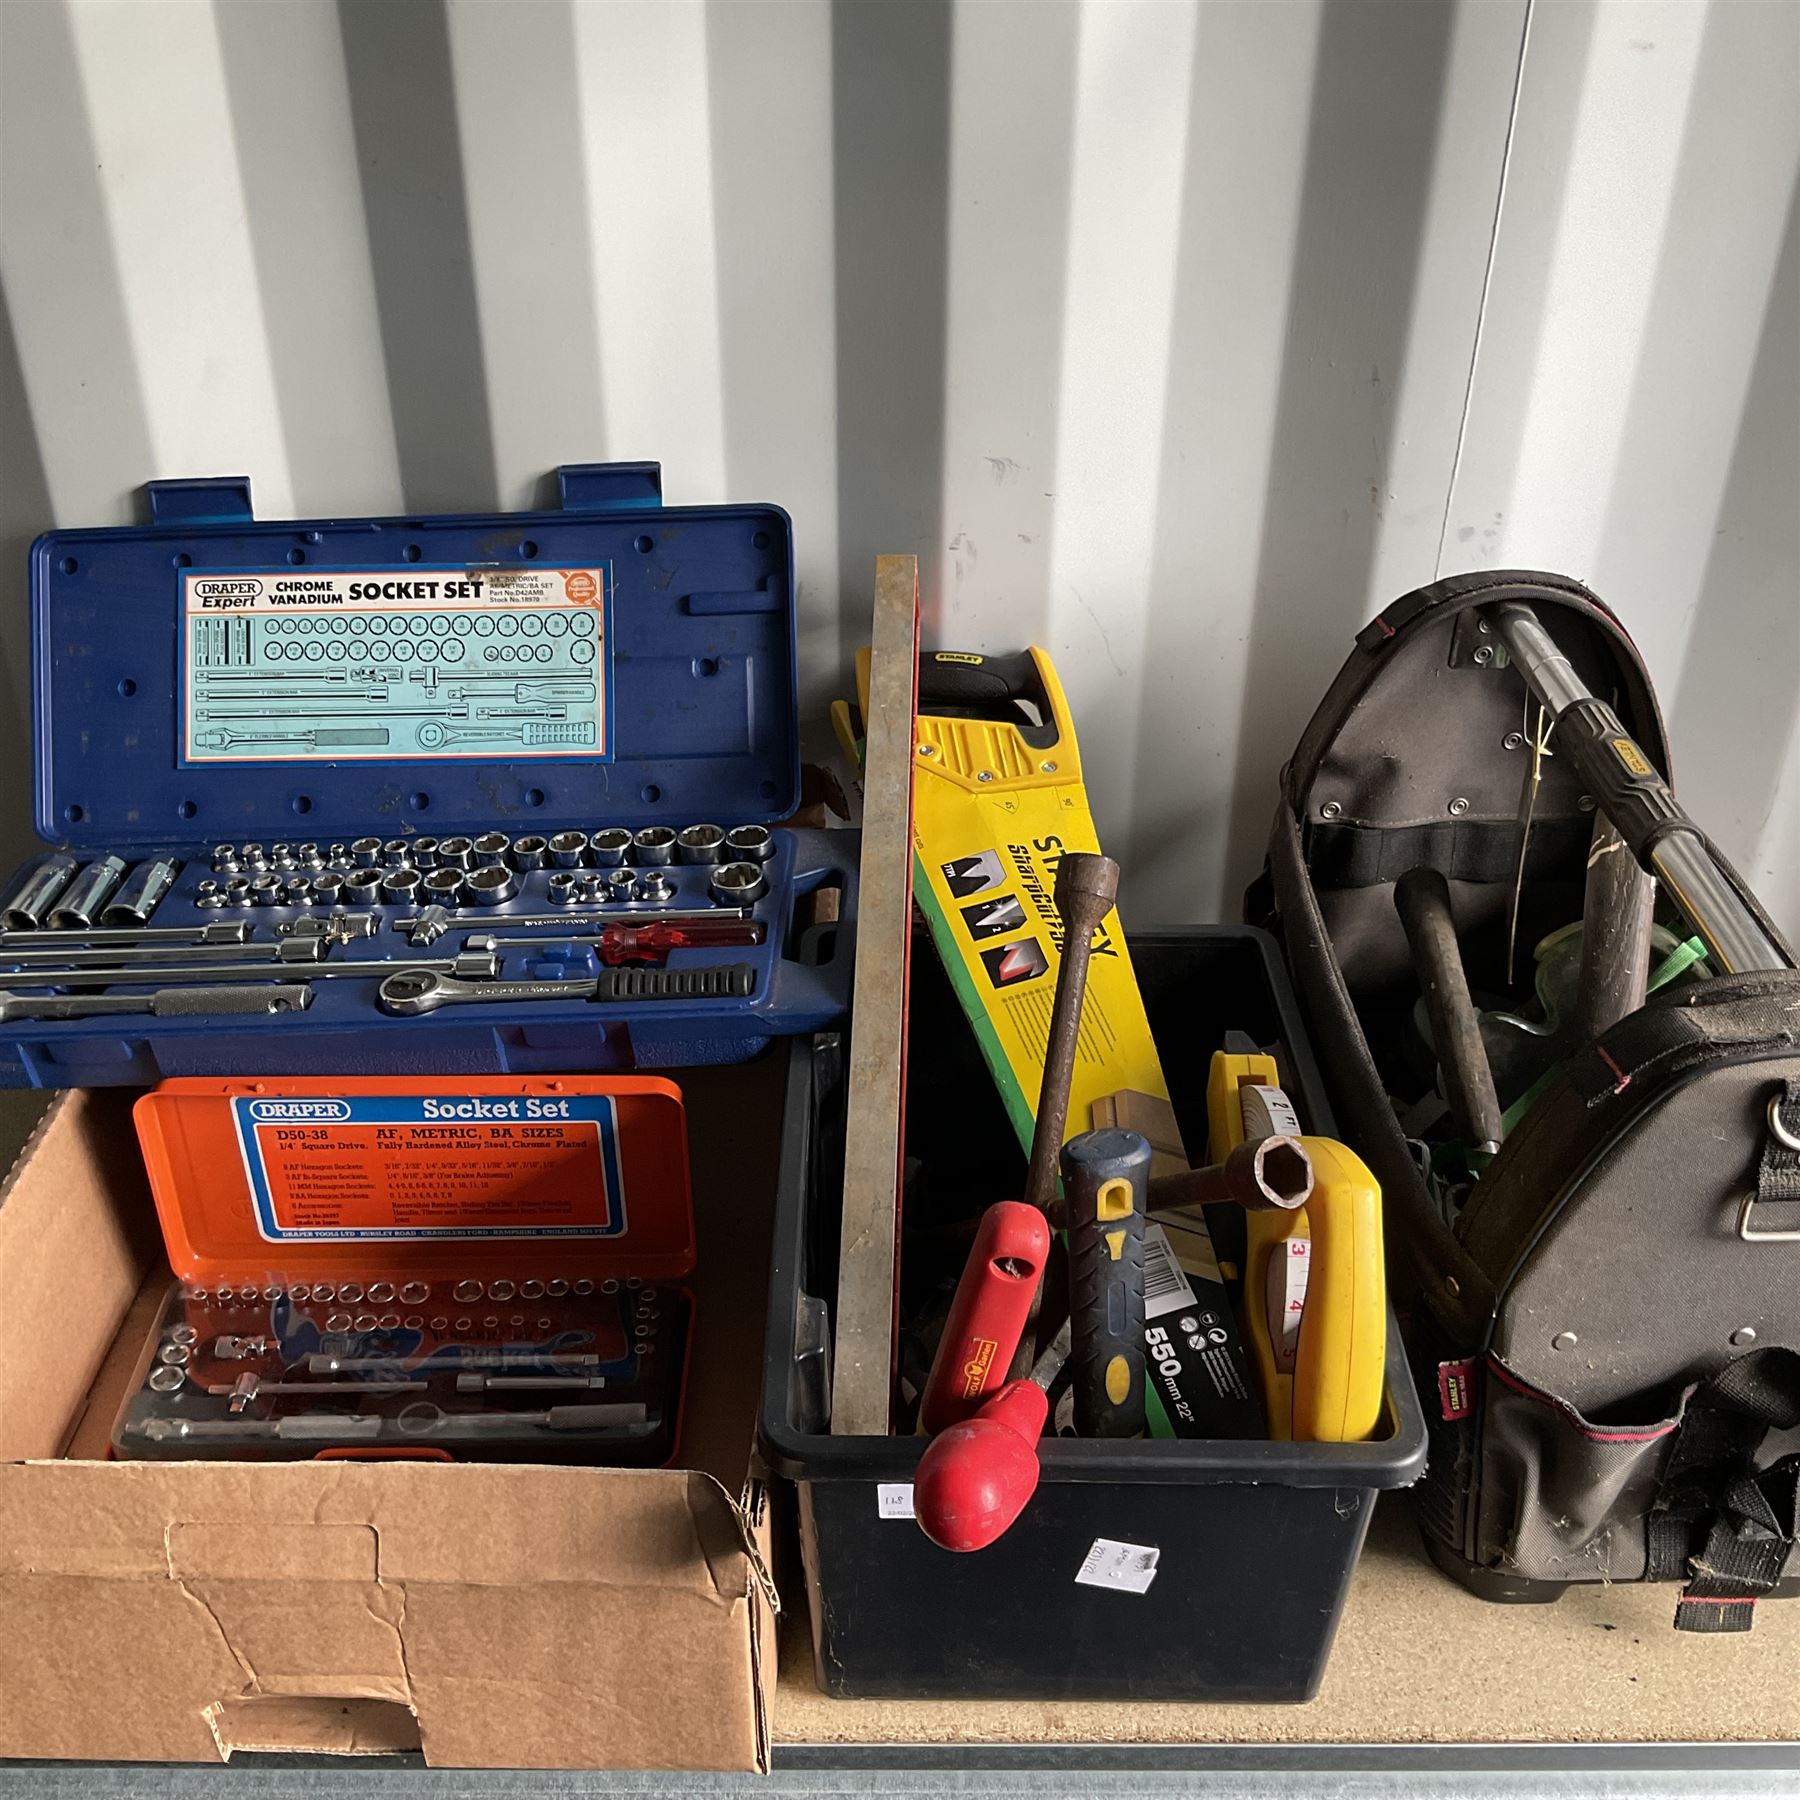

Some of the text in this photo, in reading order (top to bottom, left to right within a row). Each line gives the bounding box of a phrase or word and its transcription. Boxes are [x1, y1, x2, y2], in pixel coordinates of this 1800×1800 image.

[202, 583, 257, 594] DRAPER
[276, 581, 333, 592] CHROME
[349, 581, 484, 600] SOCKET SET
[202, 595, 256, 610] Expert
[268, 594, 343, 605] VANADIUM
[259, 1104, 342, 1117] DRAPER
[423, 1099, 569, 1118] Socket Set
[276, 1130, 328, 1140] D50-38
[376, 1128, 564, 1140] AF, METRIC, BA SIZES
[301, 1142, 335, 1151] Square
[337, 1142, 368, 1150] Drive.
[377, 1141, 403, 1150] Fully
[405, 1141, 453, 1149] Hardened
[455, 1141, 482, 1150] Alloy
[1292, 1243, 1305, 1256] 3
[1290, 1300, 1303, 1311] 4
[967, 1343, 992, 1397] WOLF Garten
